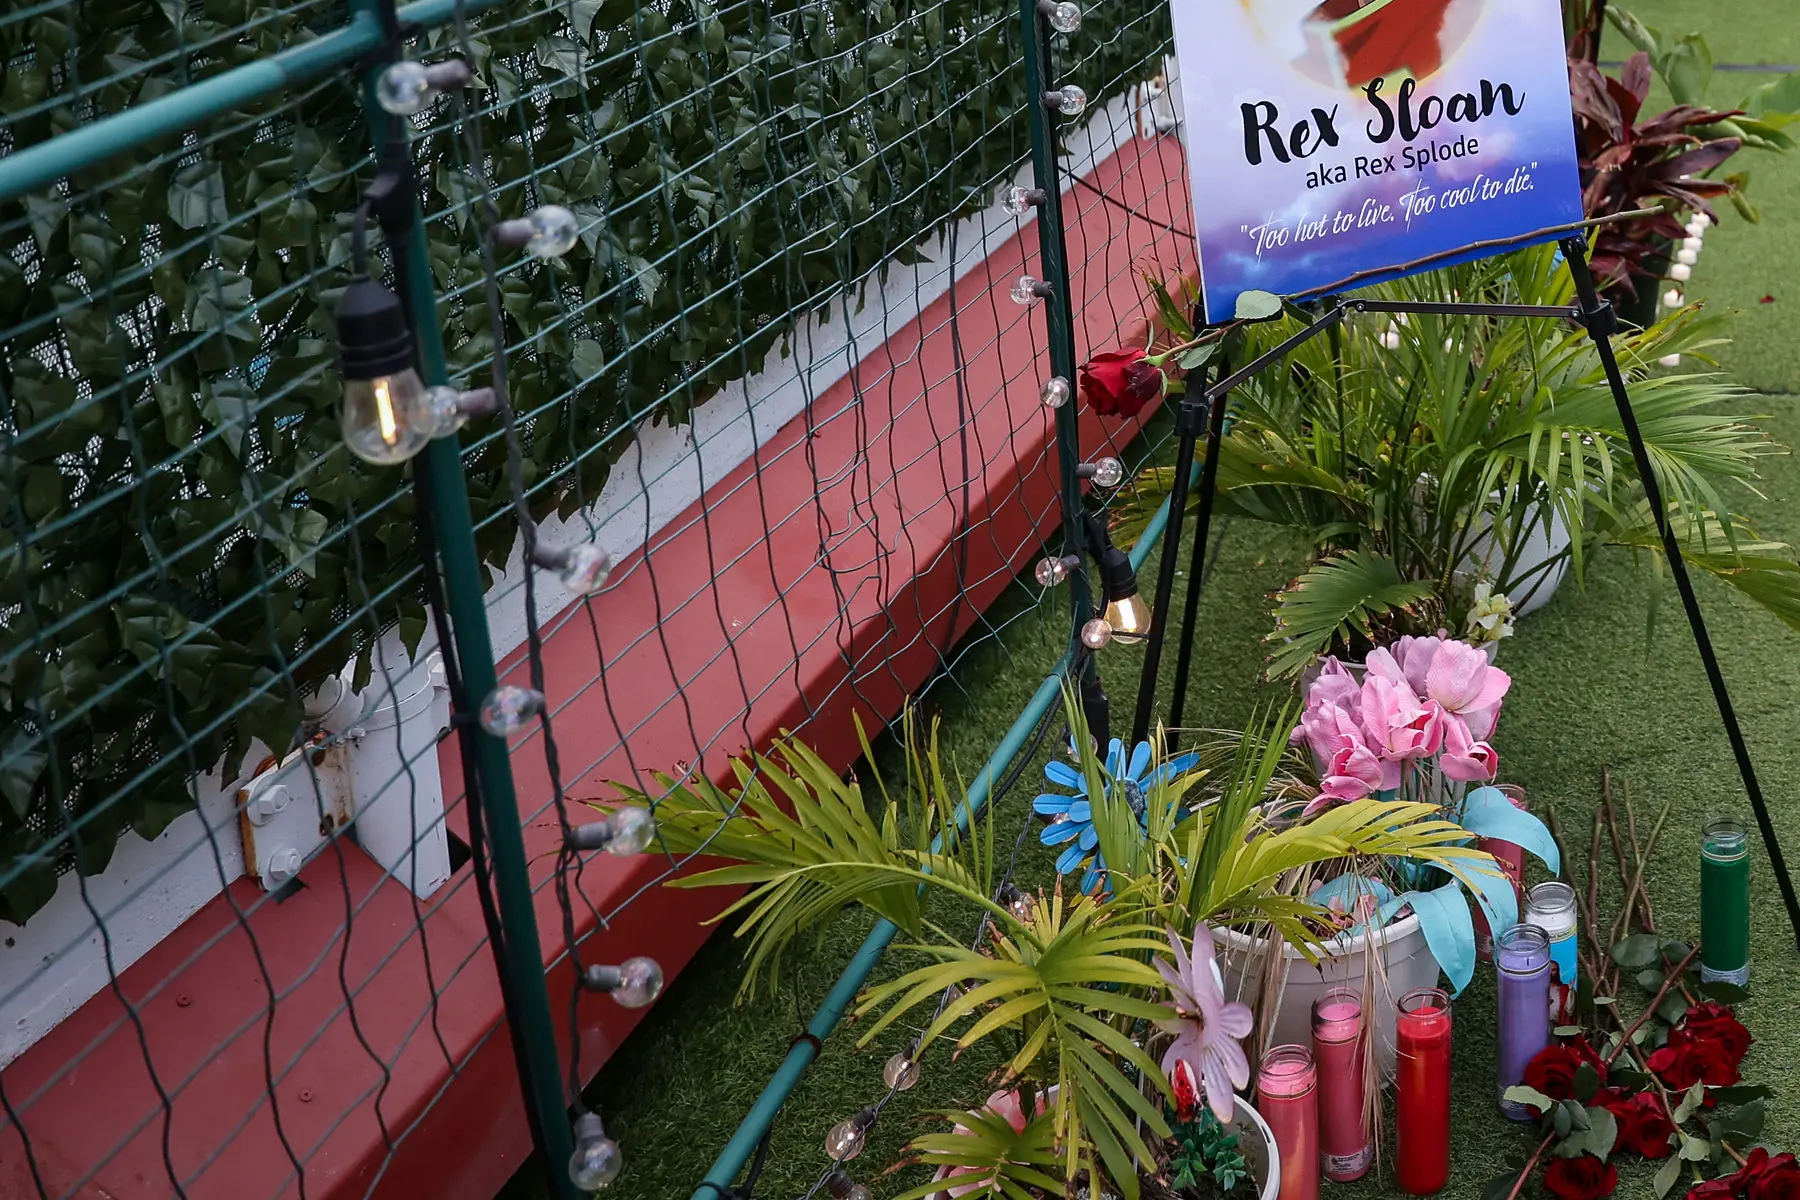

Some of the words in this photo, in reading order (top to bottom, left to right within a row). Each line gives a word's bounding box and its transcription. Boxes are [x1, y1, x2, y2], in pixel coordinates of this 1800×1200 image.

[1240, 100, 1340, 165] Rex
[1362, 77, 1526, 144] Sloan
[1306, 162, 1347, 189] aka
[1355, 154, 1396, 179] Rex
[1403, 135, 1479, 169] Splode
[1240, 211, 1290, 266] "Too
[1295, 214, 1327, 242] hot
[1333, 209, 1355, 233] to
[1357, 198, 1395, 229] live.
[1399, 179, 1437, 233] Too
[1440, 173, 1484, 208] cool
[1482, 181, 1503, 201] to
[1504, 161, 1538, 194] die."
